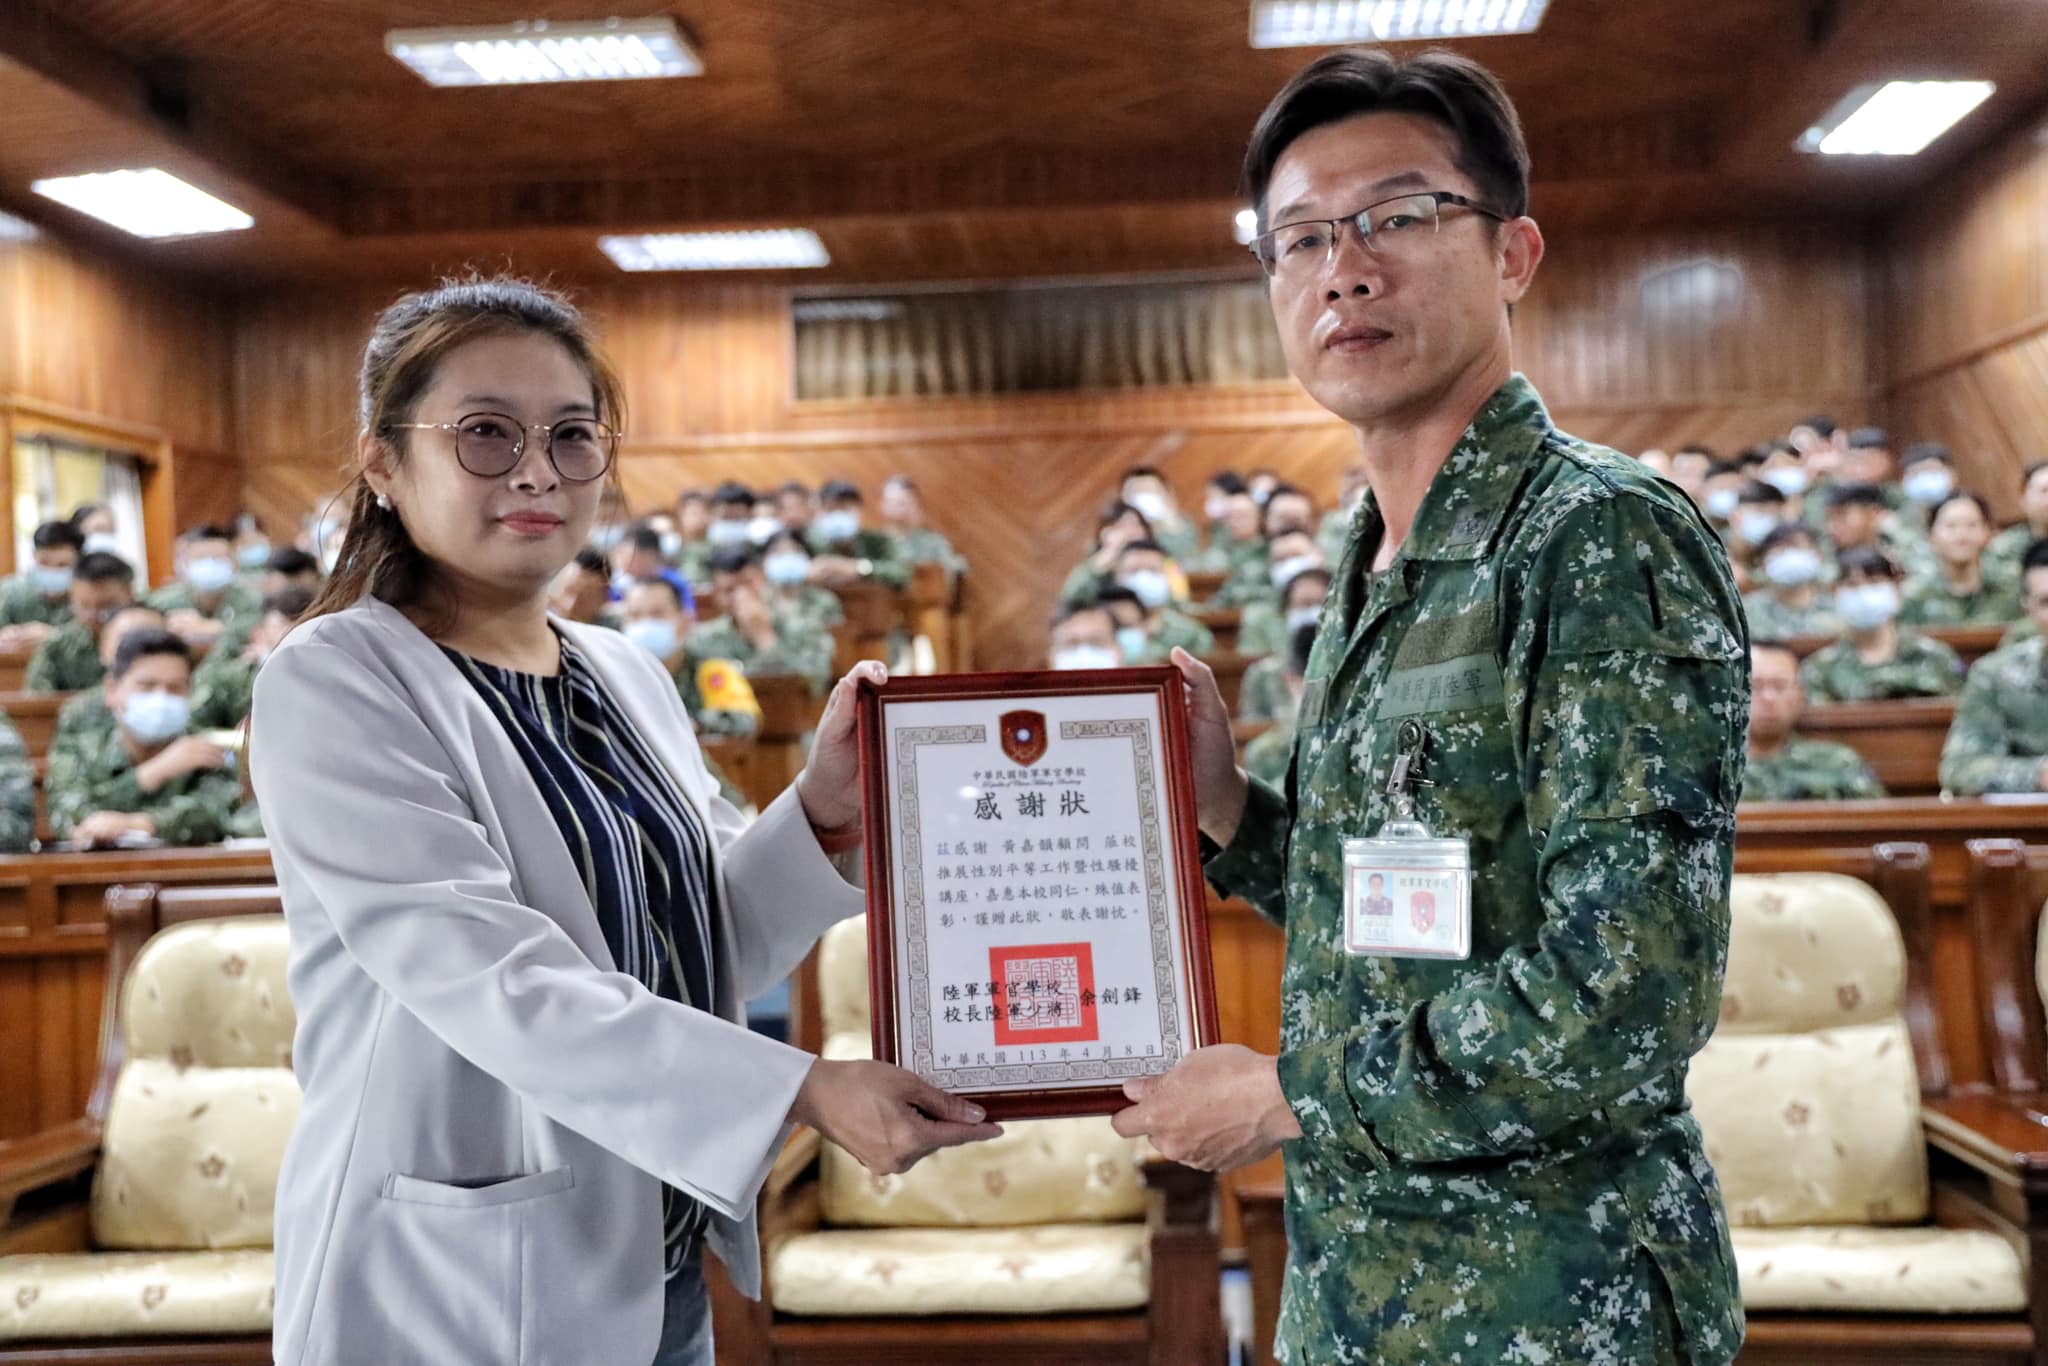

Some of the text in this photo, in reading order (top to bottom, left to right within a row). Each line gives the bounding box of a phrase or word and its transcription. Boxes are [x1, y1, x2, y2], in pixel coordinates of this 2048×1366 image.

[974, 789, 1090, 821] 感謝狀
[943, 979, 1064, 1002] 陸軍軍官學校
[943, 1001, 1063, 1024] 校長陸軍少將
